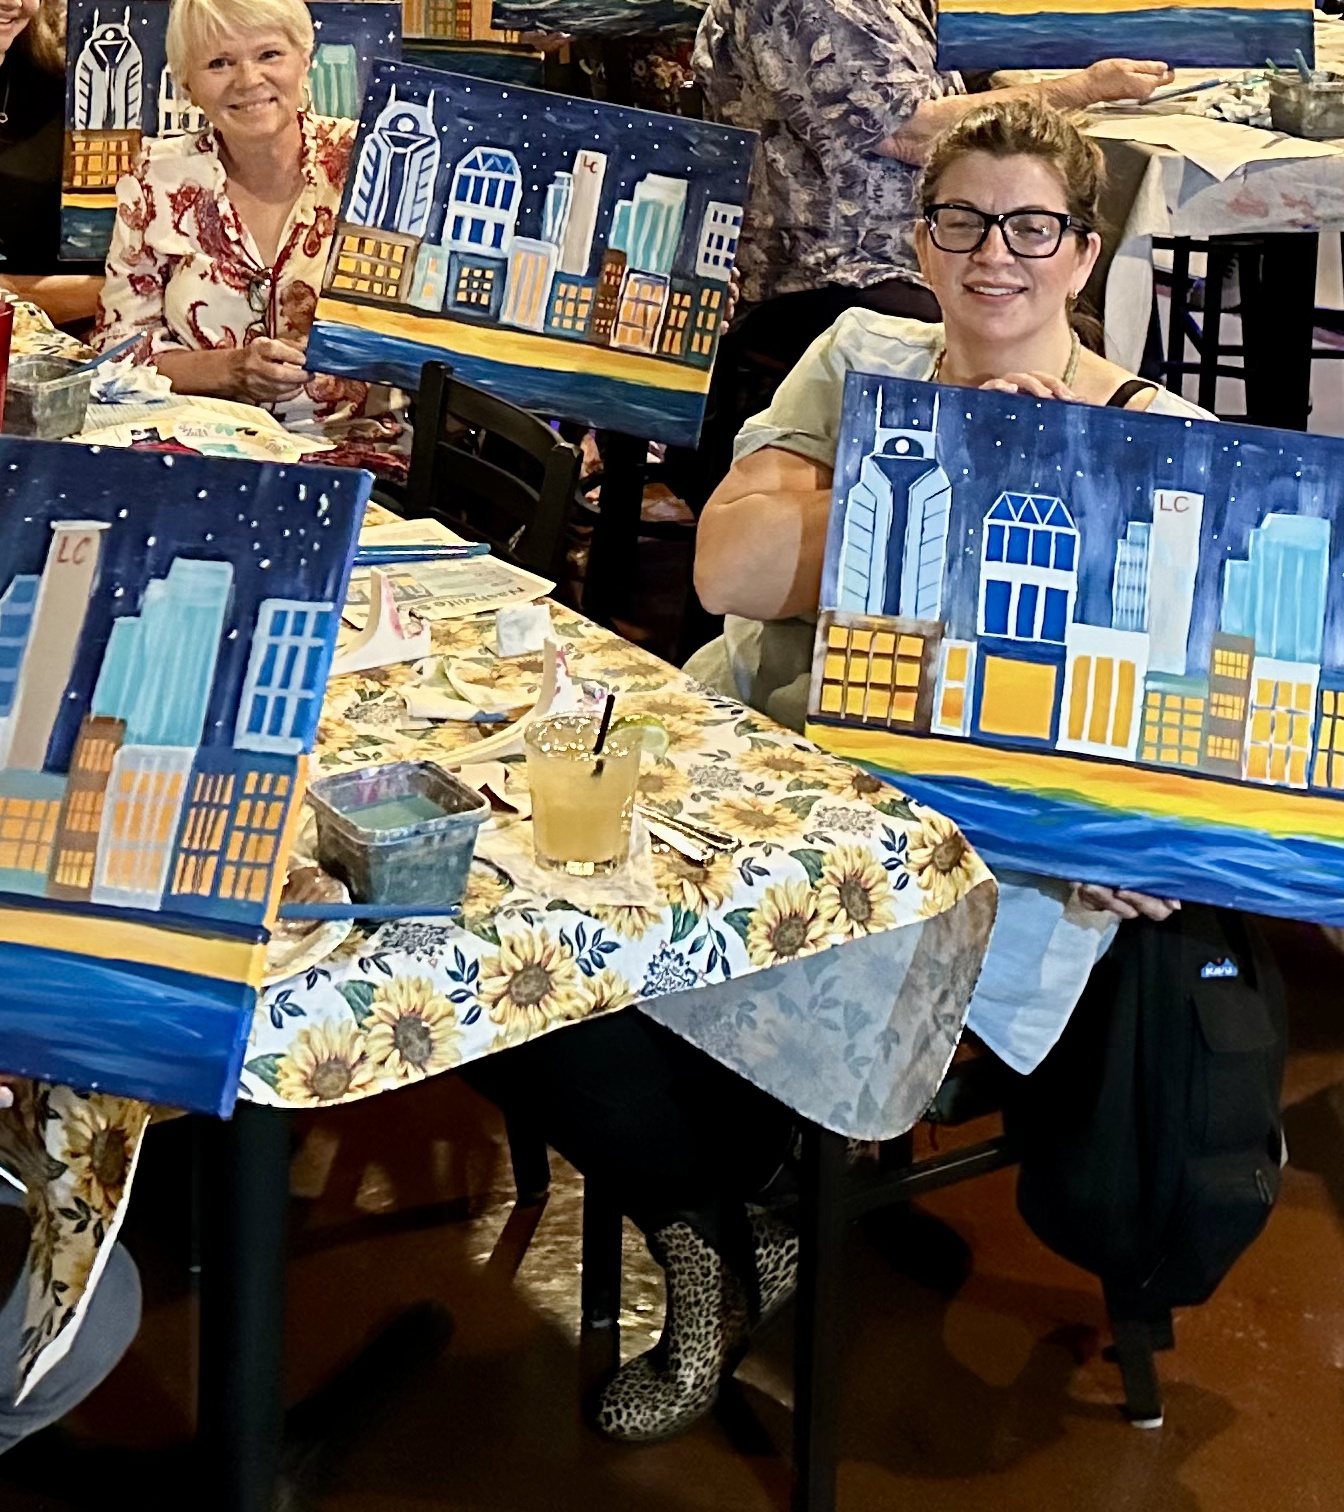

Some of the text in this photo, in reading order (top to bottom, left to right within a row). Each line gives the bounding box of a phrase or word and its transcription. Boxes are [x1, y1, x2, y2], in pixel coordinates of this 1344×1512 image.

[582, 155, 597, 174] LC
[1159, 493, 1189, 513] LC
[57, 535, 91, 565] LC
